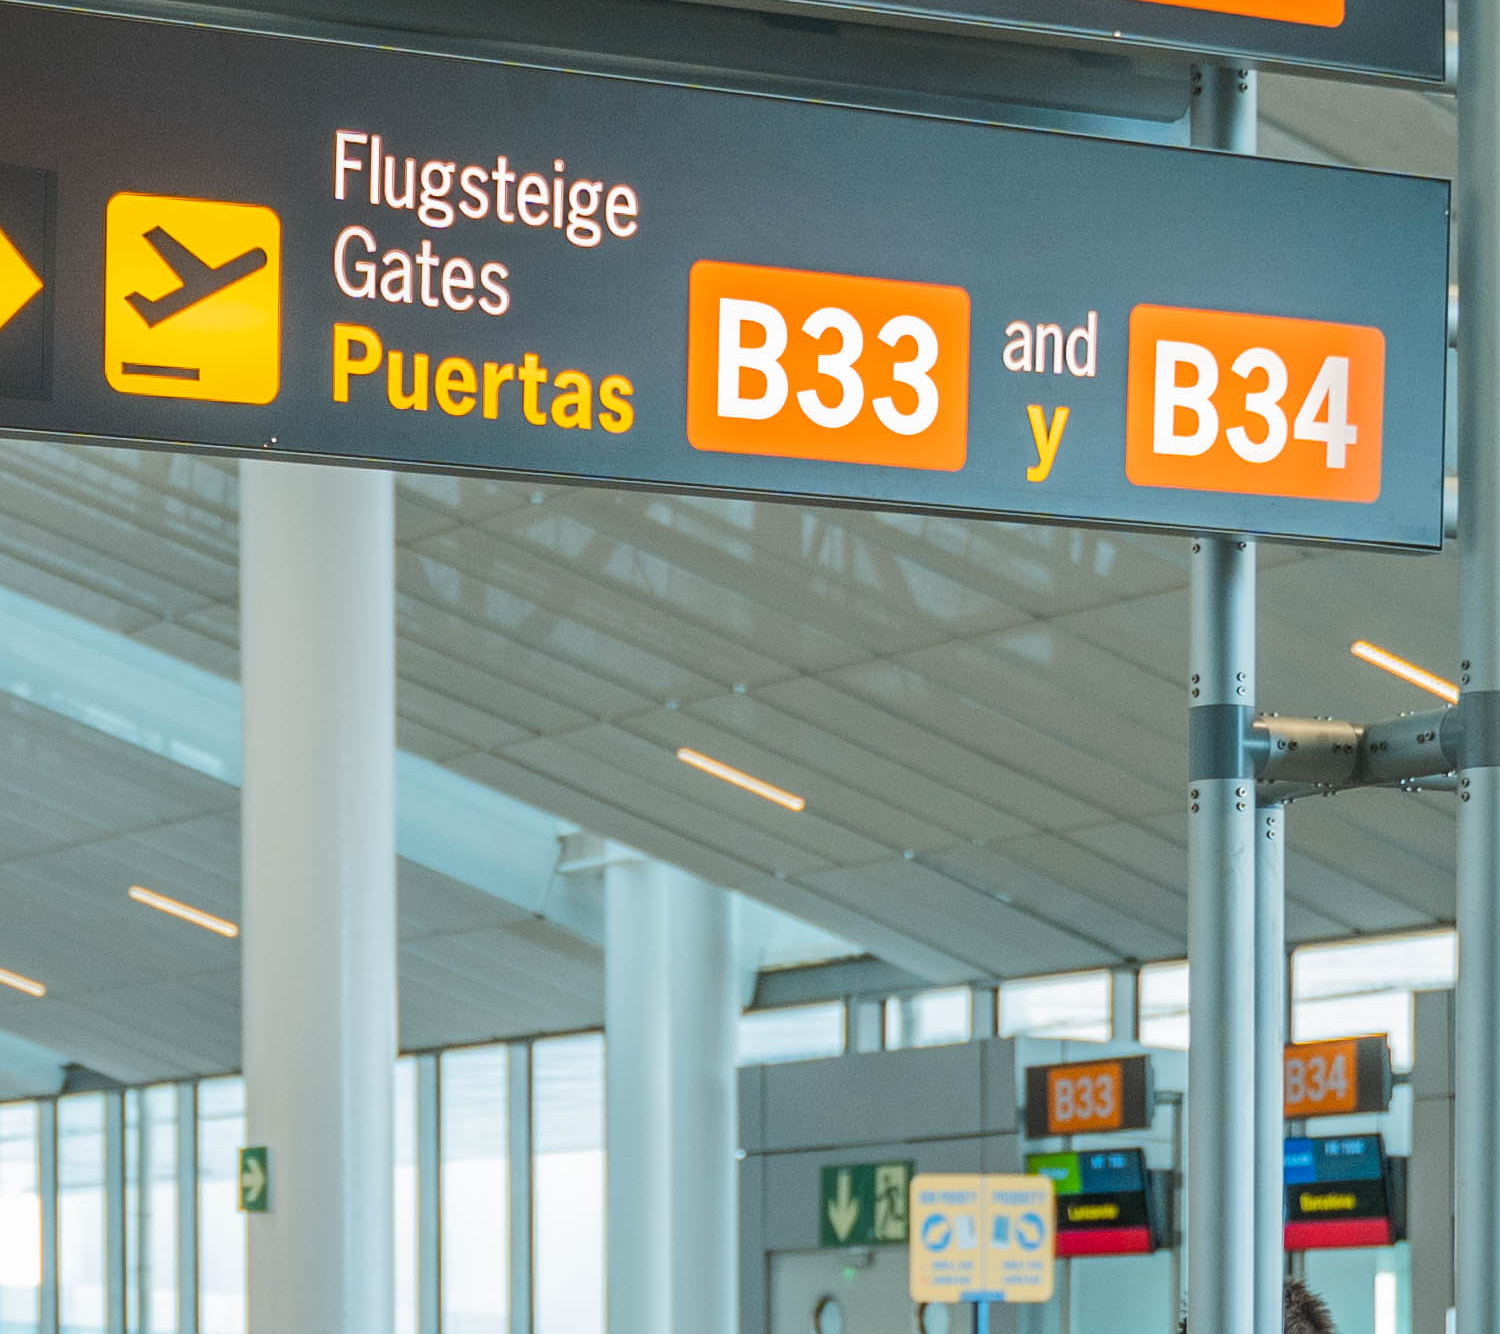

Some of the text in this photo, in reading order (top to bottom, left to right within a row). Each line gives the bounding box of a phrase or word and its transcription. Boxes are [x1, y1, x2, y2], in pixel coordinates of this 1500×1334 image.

[334, 130, 640, 249] Flugsteige
[334, 225, 511, 317] Gates
[331, 322, 636, 434] Puertas
[716, 296, 940, 437] B33
[1002, 309, 1099, 378] and
[1025, 404, 1071, 483] y
[1152, 338, 1360, 470] B34
[1055, 1074, 1115, 1122] B33
[1285, 1053, 1348, 1103] B34
